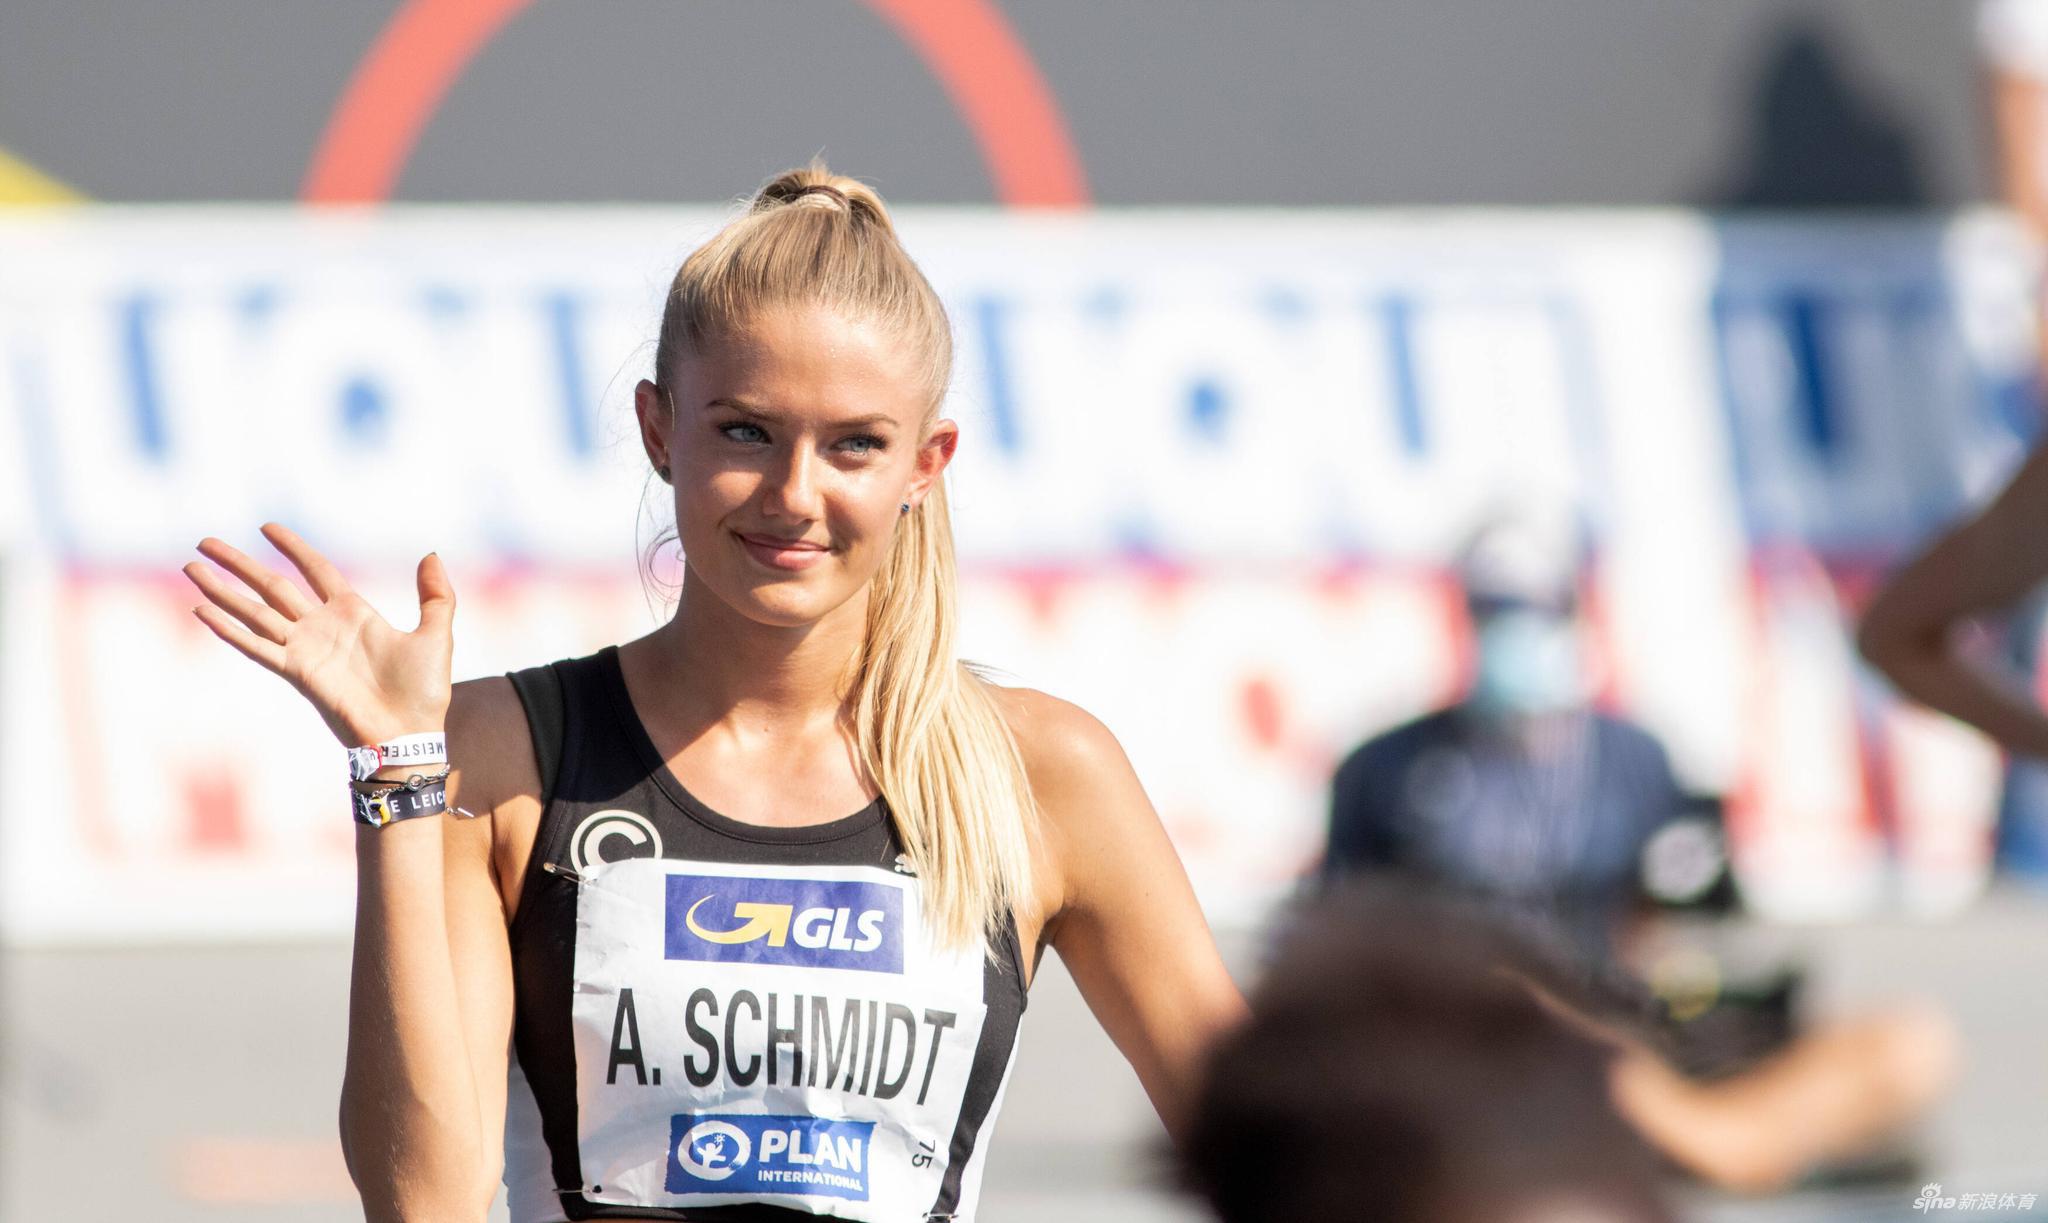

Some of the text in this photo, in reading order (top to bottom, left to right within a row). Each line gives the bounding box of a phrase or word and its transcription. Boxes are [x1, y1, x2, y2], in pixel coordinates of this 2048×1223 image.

[411, 791, 445, 809] LEIC
[792, 907, 885, 952] GLS
[606, 988, 957, 1106] A. SCHMIDT
[758, 1129, 863, 1173] PLAN
[911, 1139, 936, 1169] 75
[758, 1170, 863, 1191] INTERNATIONAL
